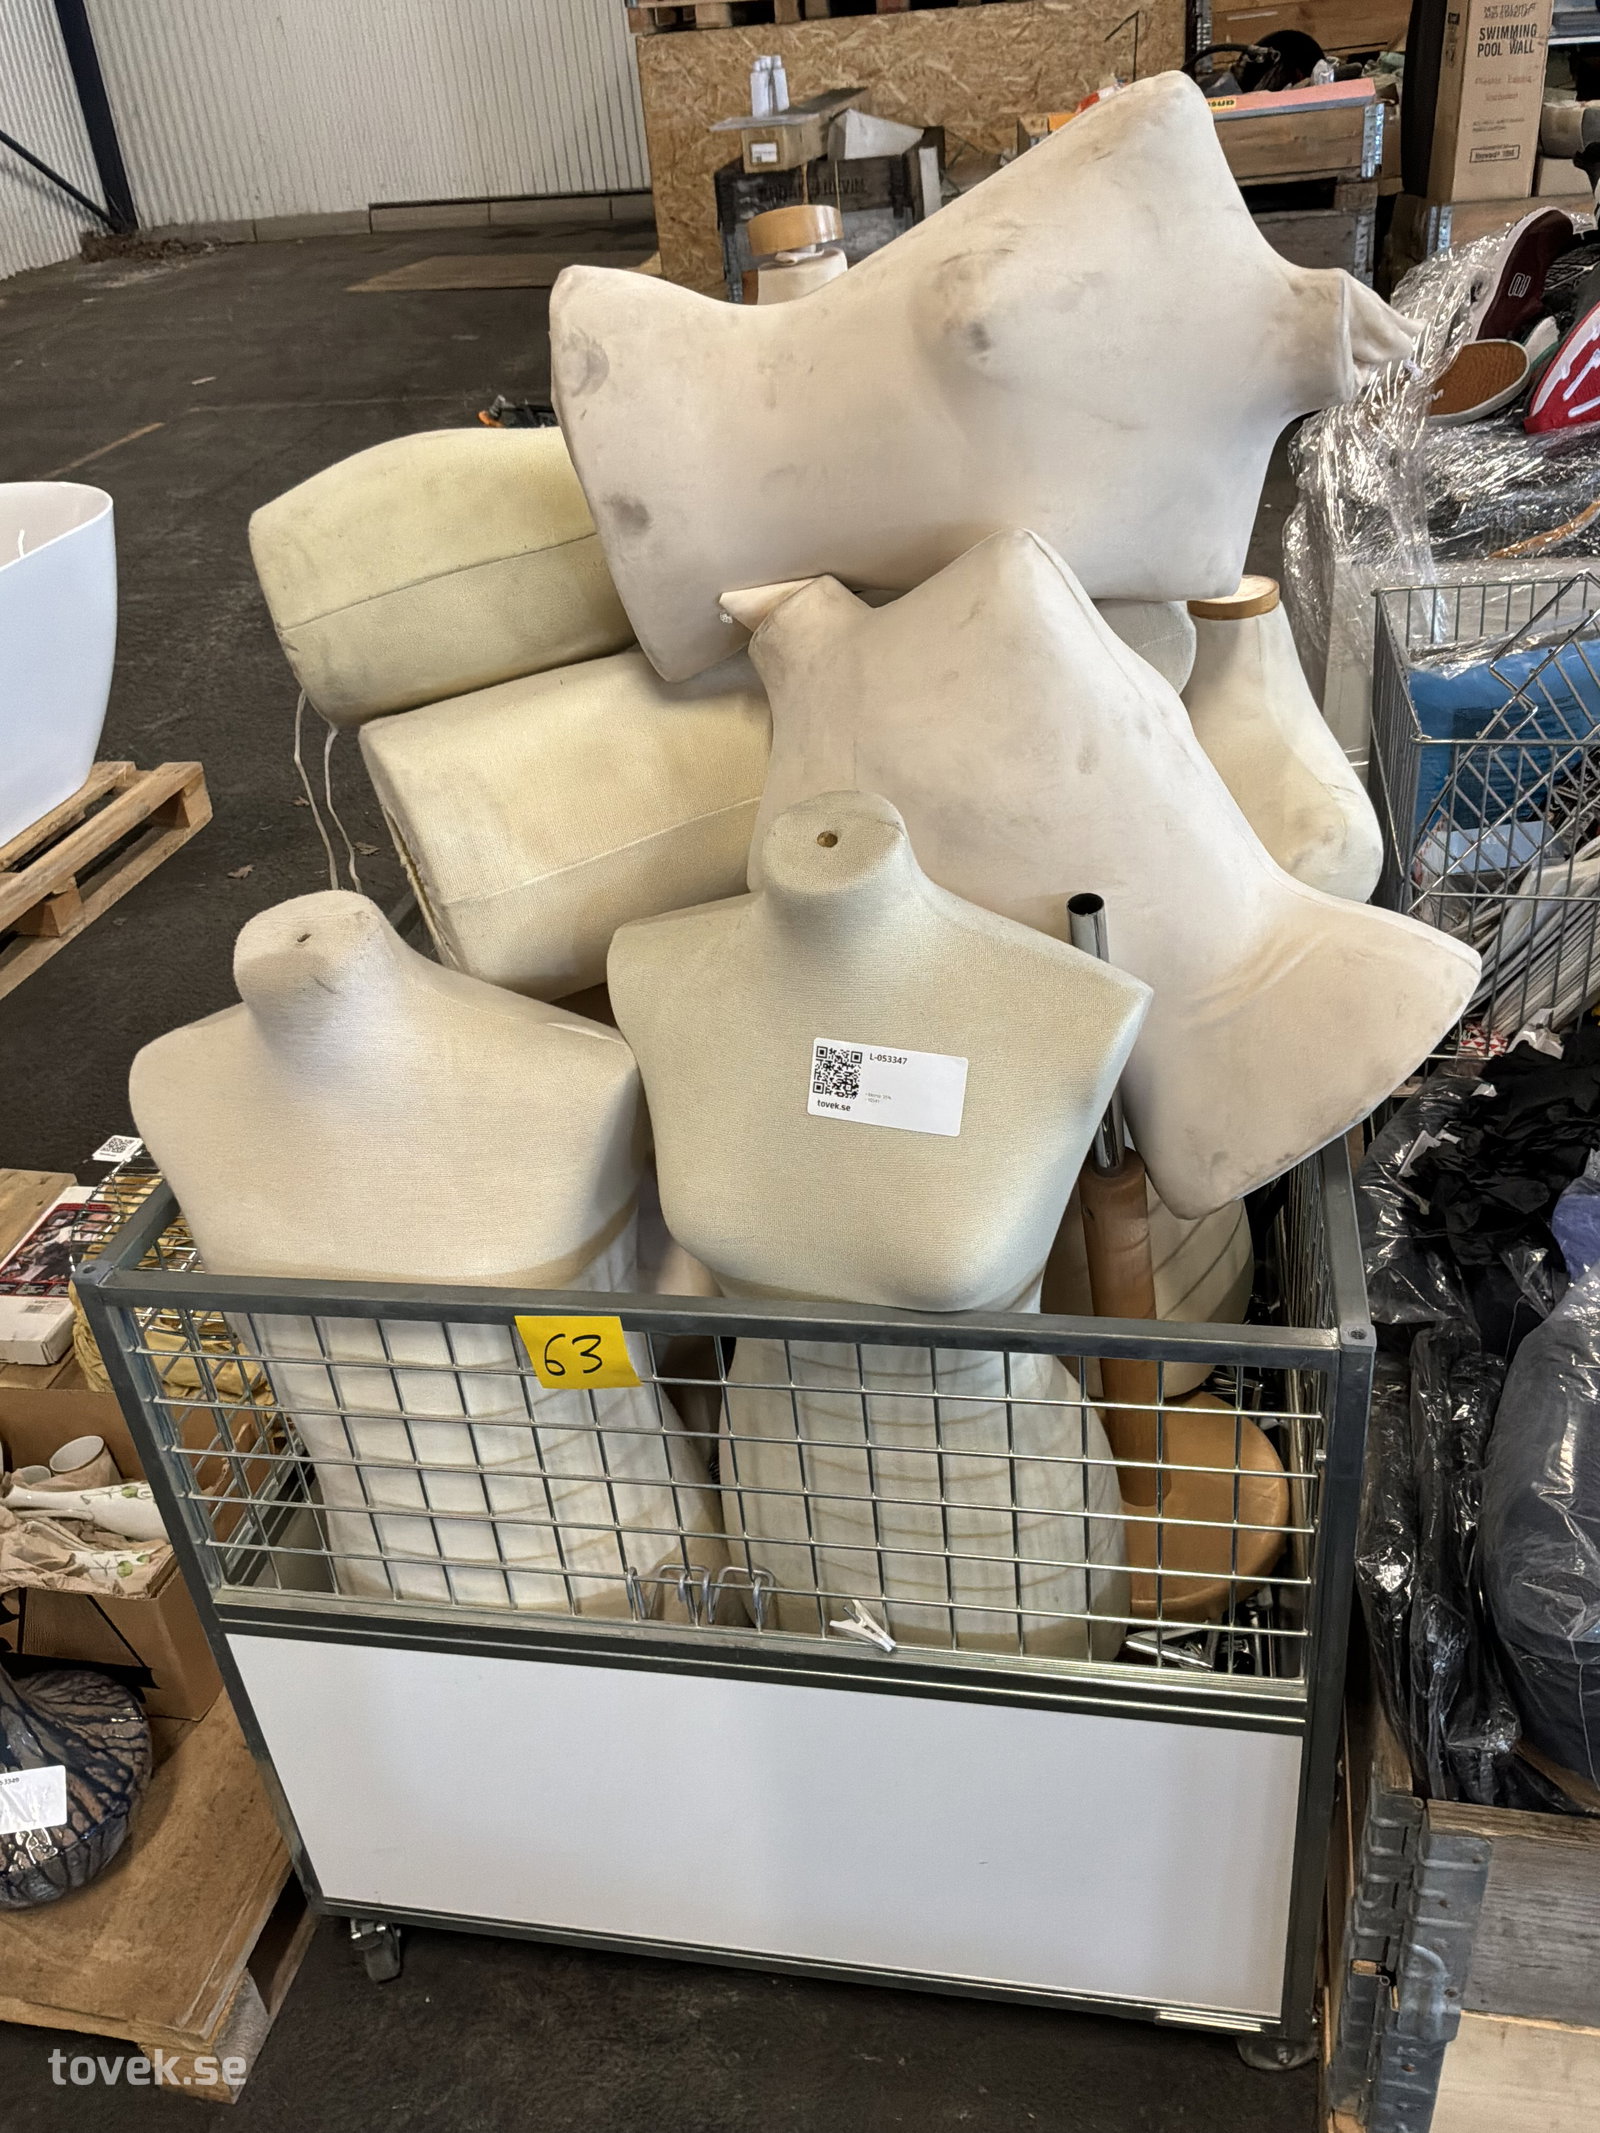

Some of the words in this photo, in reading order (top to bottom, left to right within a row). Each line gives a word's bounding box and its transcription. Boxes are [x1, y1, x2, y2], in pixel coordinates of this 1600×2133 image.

[1479, 24, 1537, 41] SWIMMING
[1477, 43, 1503, 57] POOL
[1509, 39, 1535, 55] WALL
[869, 1052, 908, 1065] L-053347
[817, 1099, 851, 1112] tovek.se
[544, 1333, 603, 1376] 63
